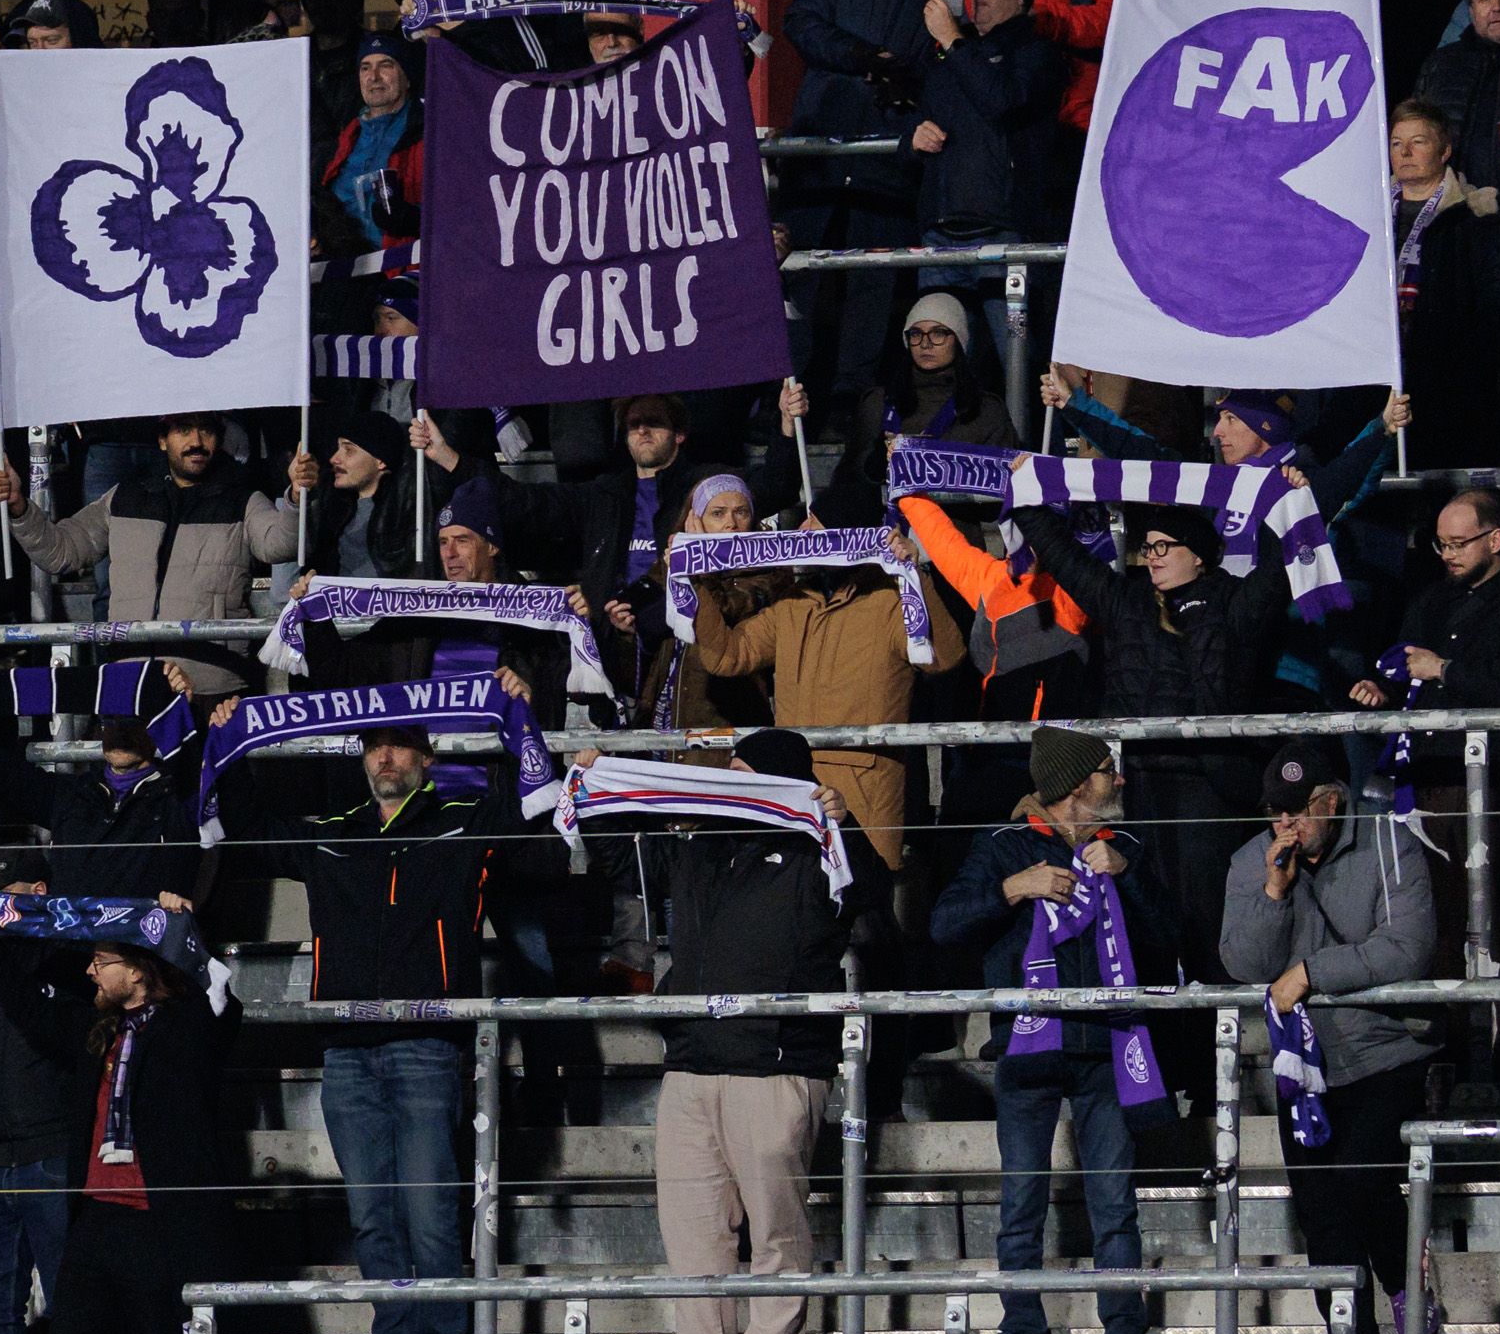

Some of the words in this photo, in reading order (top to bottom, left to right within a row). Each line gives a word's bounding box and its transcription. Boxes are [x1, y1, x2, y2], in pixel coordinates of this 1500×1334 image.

[488, 65, 648, 167] COME
[655, 33, 727, 140] ON
[1173, 36, 1352, 124] FAK
[488, 165, 609, 267] YOU
[623, 141, 740, 252] VIOLET
[1415, 201, 1435, 233] DONAU
[537, 254, 701, 366] GIRLS
[891, 451, 1005, 492] AUSTRIA
[684, 544, 719, 575] FK
[727, 533, 831, 569] Austria
[840, 528, 892, 557] Wie
[246, 686, 386, 734] AUSTRIA
[403, 678, 494, 711] WIEN
